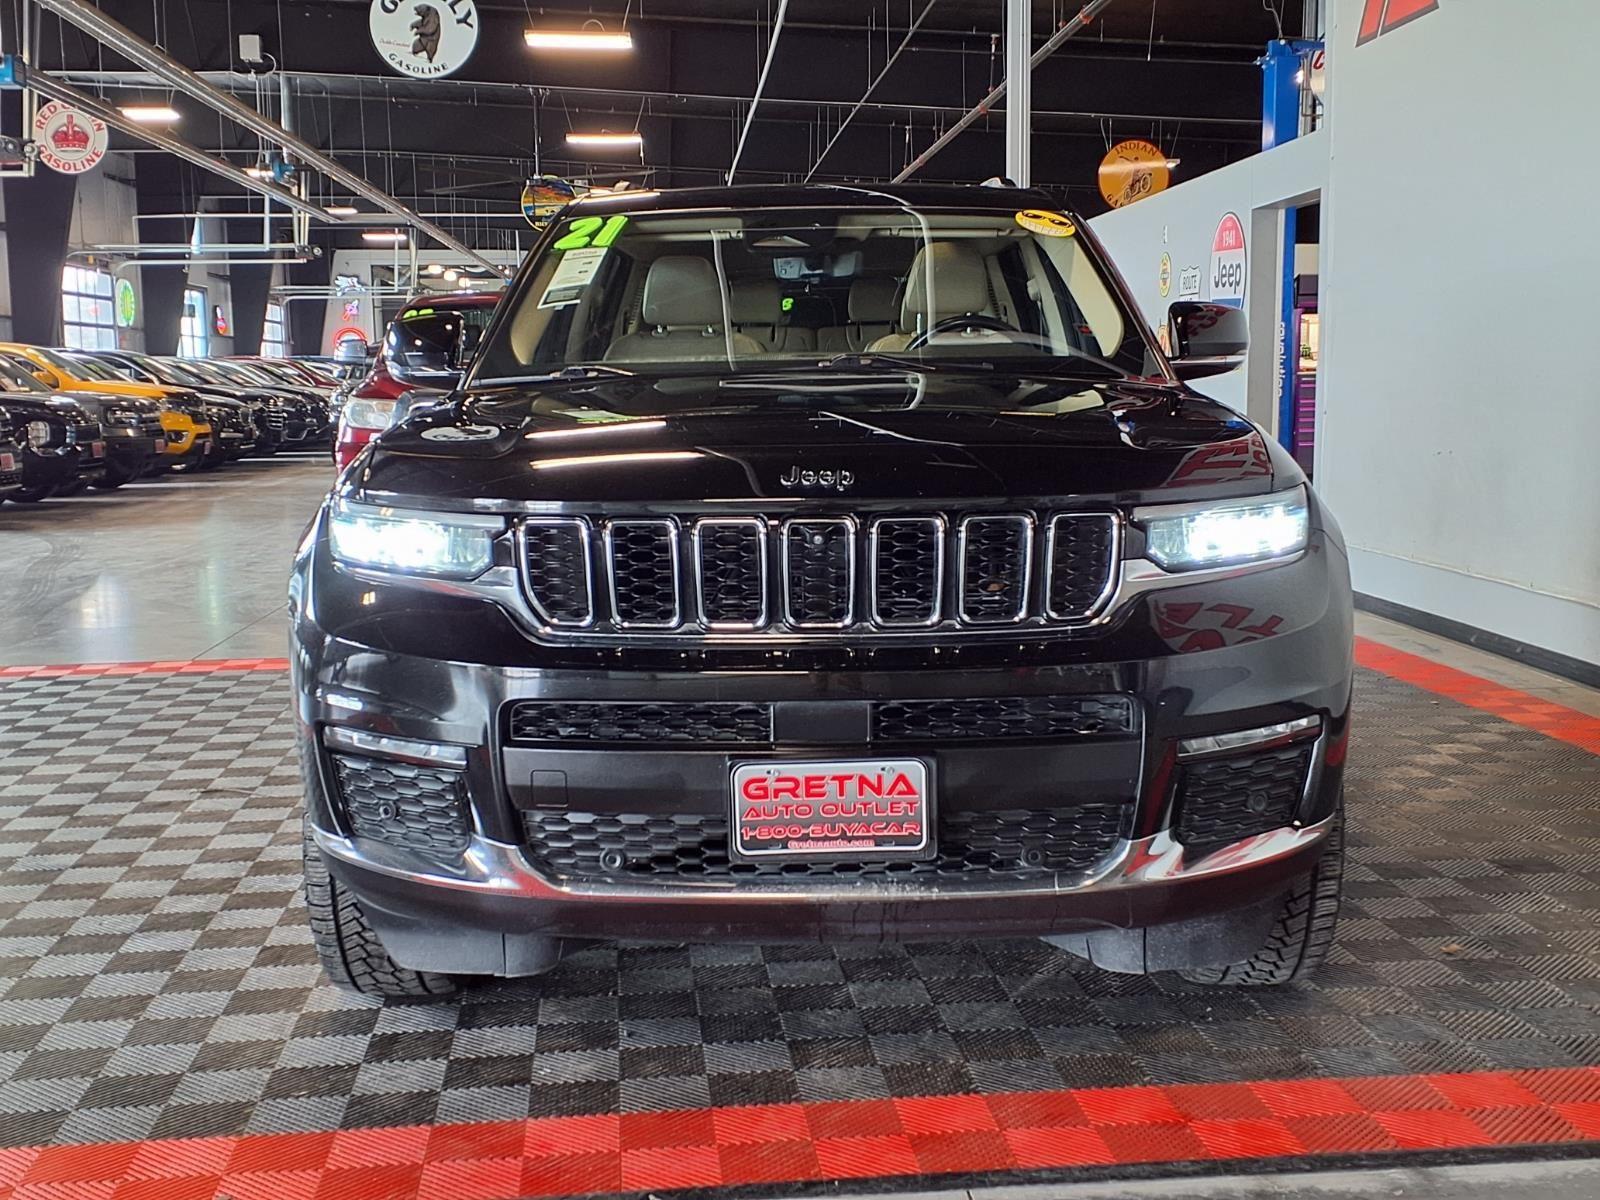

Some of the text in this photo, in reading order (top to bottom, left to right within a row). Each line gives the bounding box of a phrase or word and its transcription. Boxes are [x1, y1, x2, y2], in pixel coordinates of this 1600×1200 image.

[388, 53, 449, 74] GASOLINE
[35, 103, 58, 130] RED
[39, 144, 103, 172] GASOLINE
[1115, 141, 1158, 156] INDIAN
[553, 215, 628, 250] 21
[1222, 229, 1236, 247] 1941
[1182, 274, 1198, 290] ROUTE
[1213, 256, 1242, 295] Jeep
[780, 464, 855, 492] Jeep
[741, 772, 921, 801] GRETNA
[741, 801, 921, 822] AUTO OUTLET
[741, 822, 921, 841] 1-800-BUYACAR
